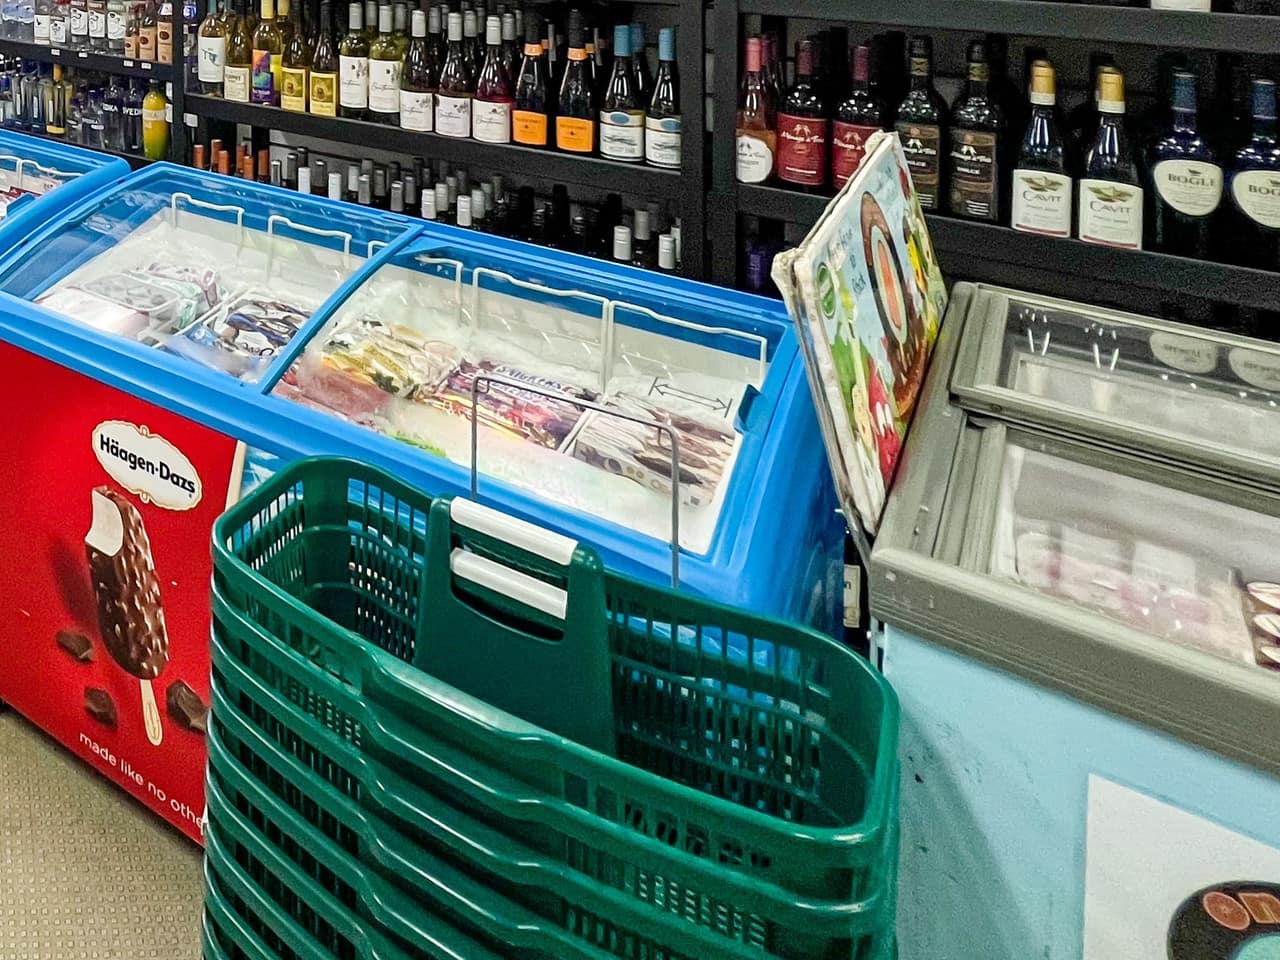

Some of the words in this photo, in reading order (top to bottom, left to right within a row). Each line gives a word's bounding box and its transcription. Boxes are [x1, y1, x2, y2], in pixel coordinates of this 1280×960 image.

[99, 433, 196, 495] Häagen-Dazs
[79, 732, 117, 767] made
[120, 758, 145, 786] like
[147, 781, 167, 802] no
[170, 798, 205, 830] othe
